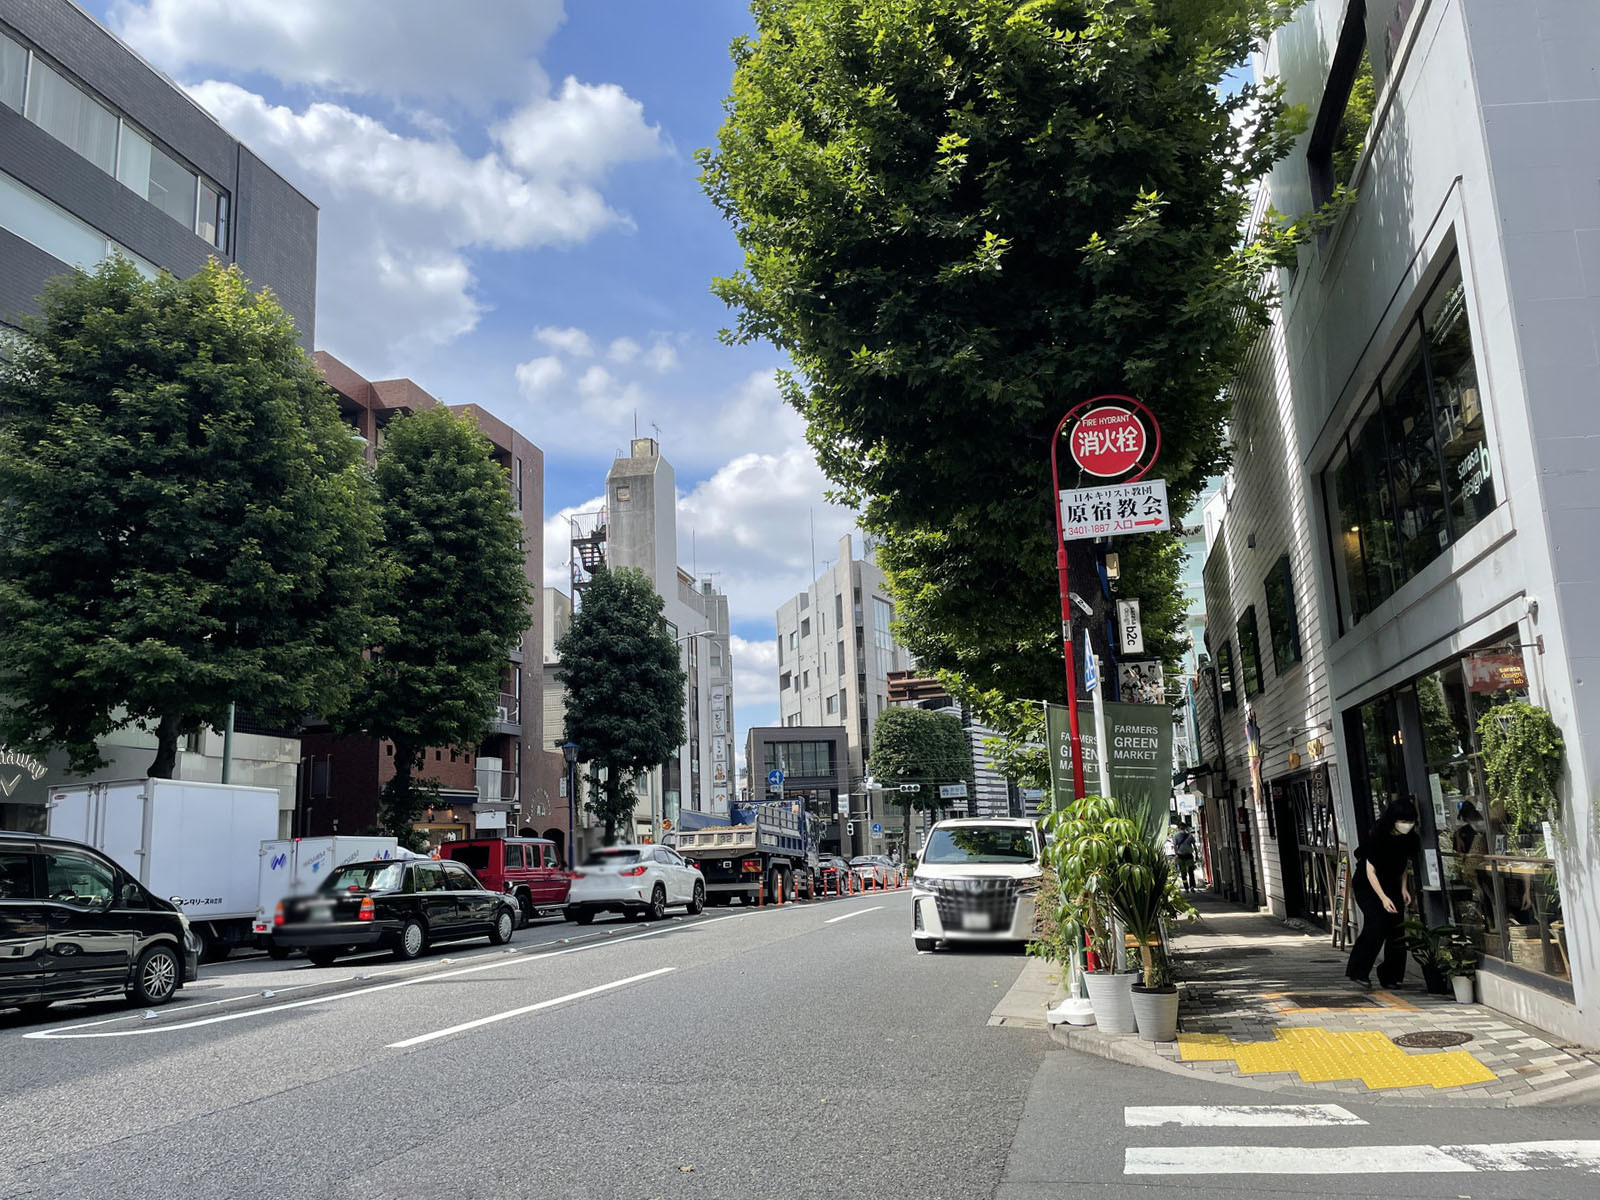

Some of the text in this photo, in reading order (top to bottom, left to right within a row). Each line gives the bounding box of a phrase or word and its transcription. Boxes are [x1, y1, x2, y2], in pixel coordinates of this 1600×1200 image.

[1082, 415, 1130, 427] FIRE HYDRANT
[1078, 426, 1138, 457] 消火栓
[1457, 447, 1480, 480] sarasa
[1074, 486, 1152, 503] 日本キリスト教団
[1067, 496, 1162, 523] 原宿教会
[1068, 519, 1133, 535] 3401-1887 入口
[1126, 626, 1138, 646] b2c
[1114, 725, 1159, 735] FARMERS
[1060, 731, 1098, 745] FAMERS
[1114, 736, 1159, 749] GREEN
[1113, 750, 1158, 760] MARKET
[1059, 759, 1100, 773] MAKET
